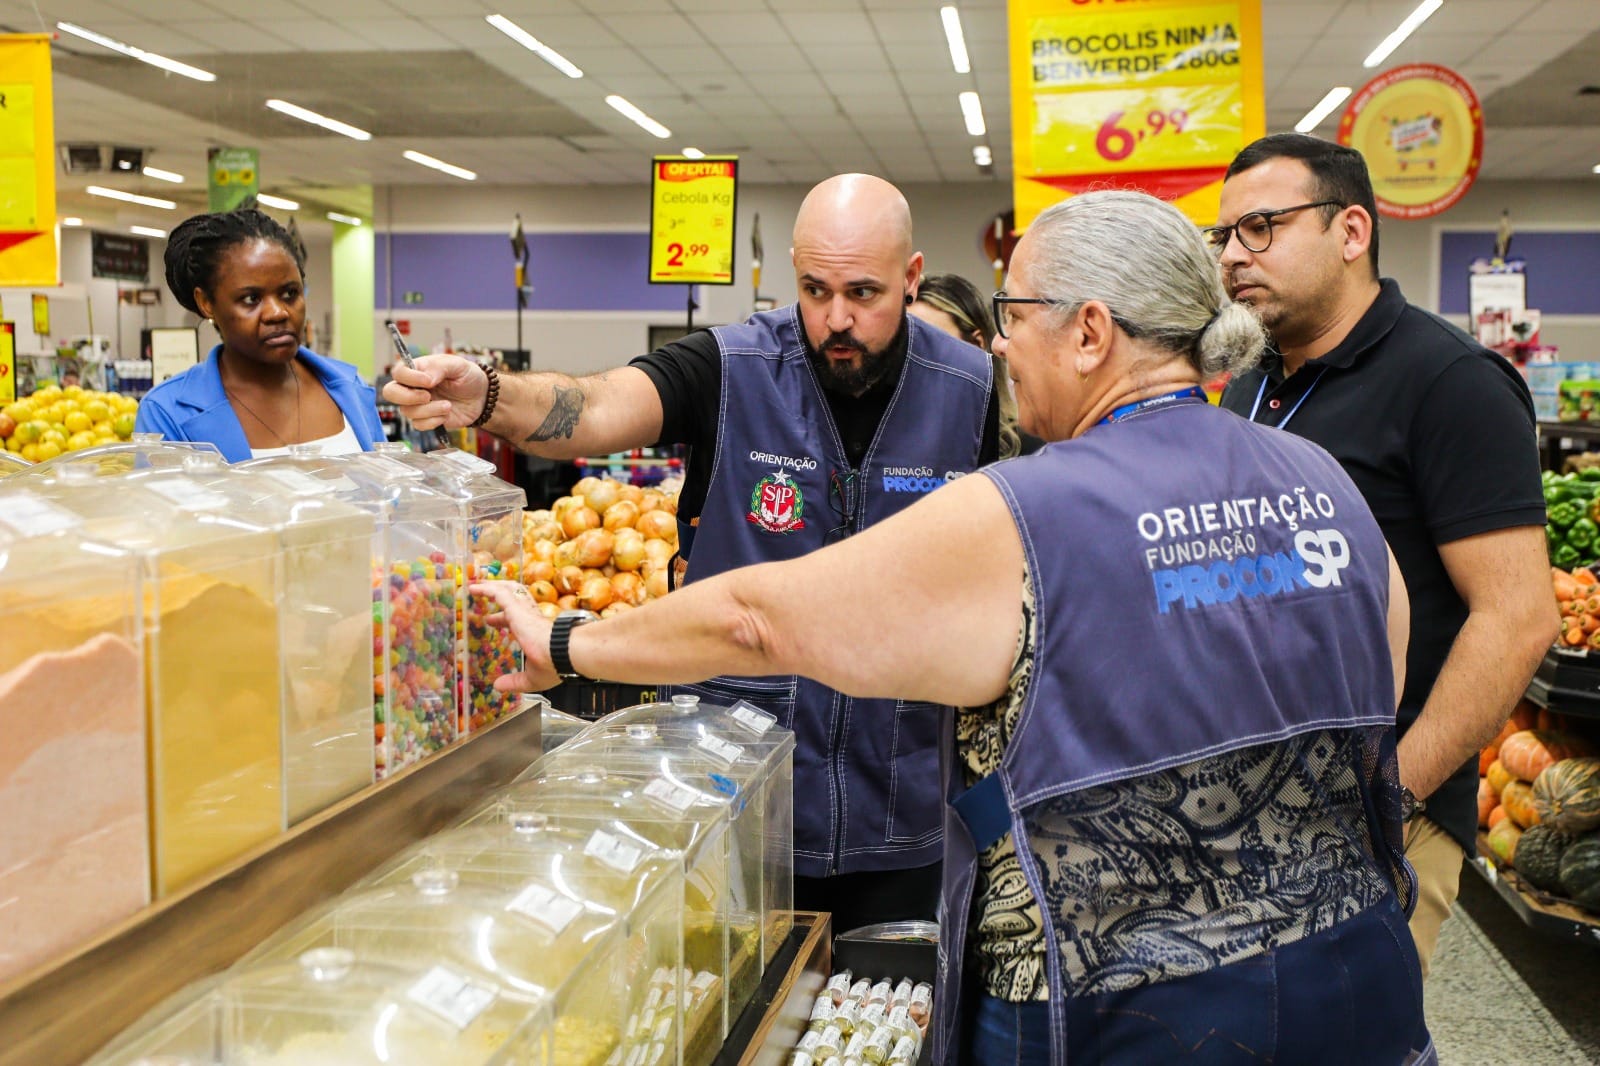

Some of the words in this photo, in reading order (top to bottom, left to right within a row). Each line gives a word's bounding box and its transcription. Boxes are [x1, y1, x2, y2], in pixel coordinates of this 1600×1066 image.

[1032, 31, 1158, 56] BROCOLIS
[1165, 23, 1237, 46] NINJA
[1033, 54, 1167, 81] BENVERDE
[1095, 109, 1188, 161] 6,99
[662, 191, 709, 204] Cebola
[713, 192, 731, 206] Kg
[667, 243, 709, 267] 2,99
[750, 451, 817, 471] ORIENTAÇÃO
[883, 466, 934, 478] FUNDAÇÃO
[1137, 486, 1335, 541] ORIENTAÇÃO
[1146, 529, 1256, 570] FUNDAÇÃO
